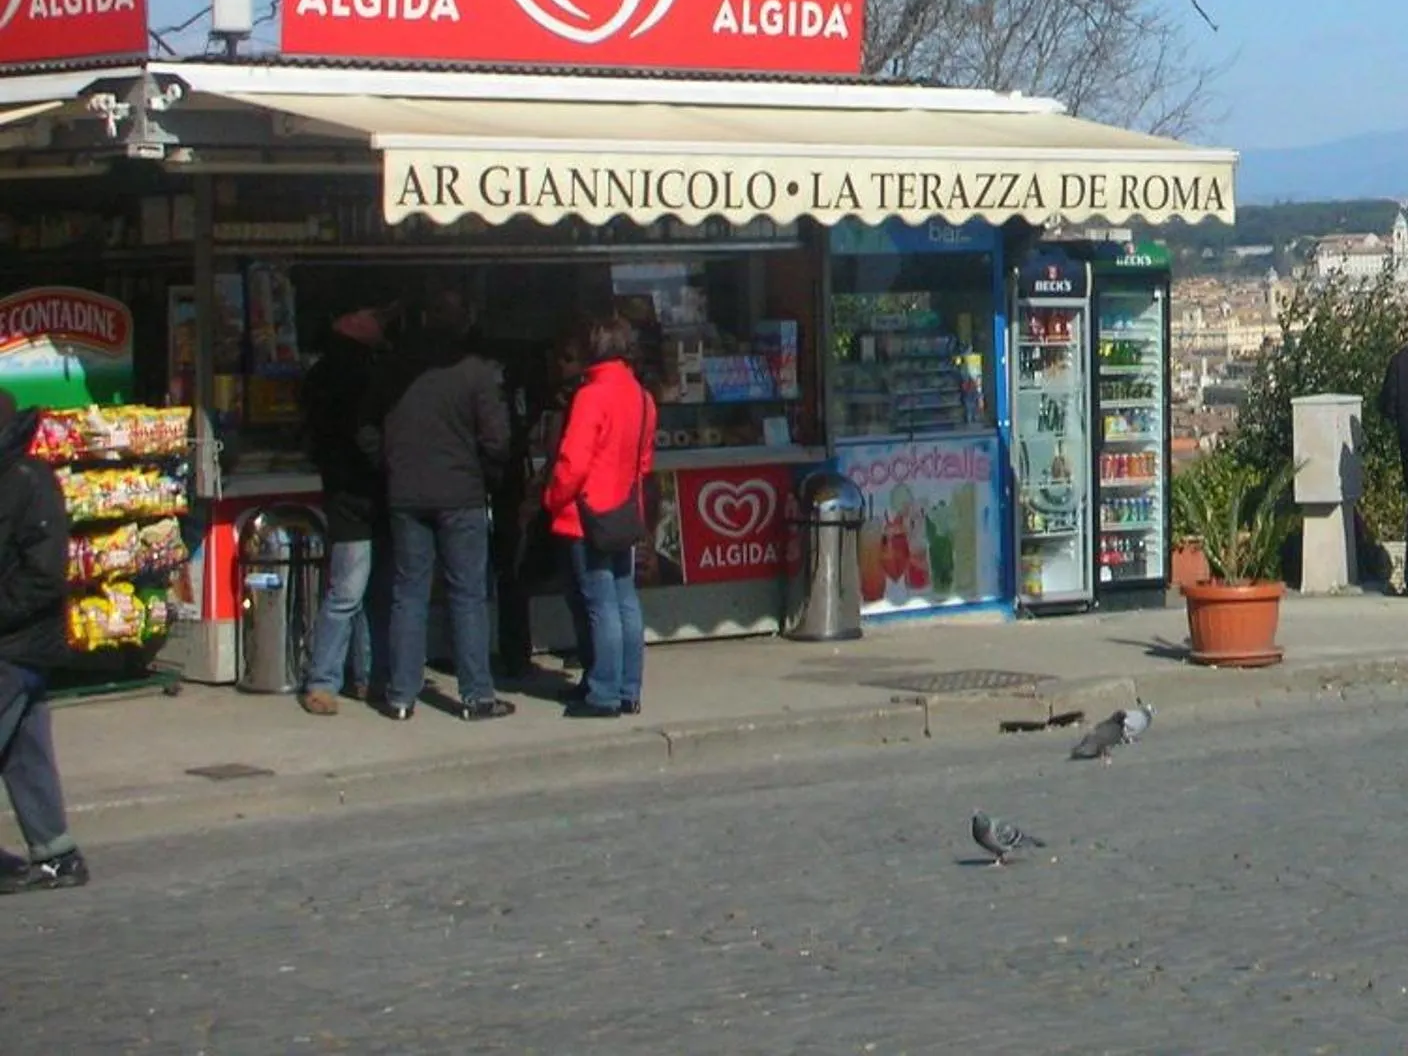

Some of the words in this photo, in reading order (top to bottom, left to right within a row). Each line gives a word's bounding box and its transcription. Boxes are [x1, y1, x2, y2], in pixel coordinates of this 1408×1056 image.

[397, 164, 463, 207] AR
[479, 164, 777, 210] GIANNICOLO
[811, 171, 862, 208] LA
[871, 171, 1046, 210] TERAZZA
[1060, 173, 1107, 211] DE
[1120, 175, 1227, 211] ROMA
[8, 298, 117, 342] CONTADINE
[699, 541, 778, 568] ALGIDA
